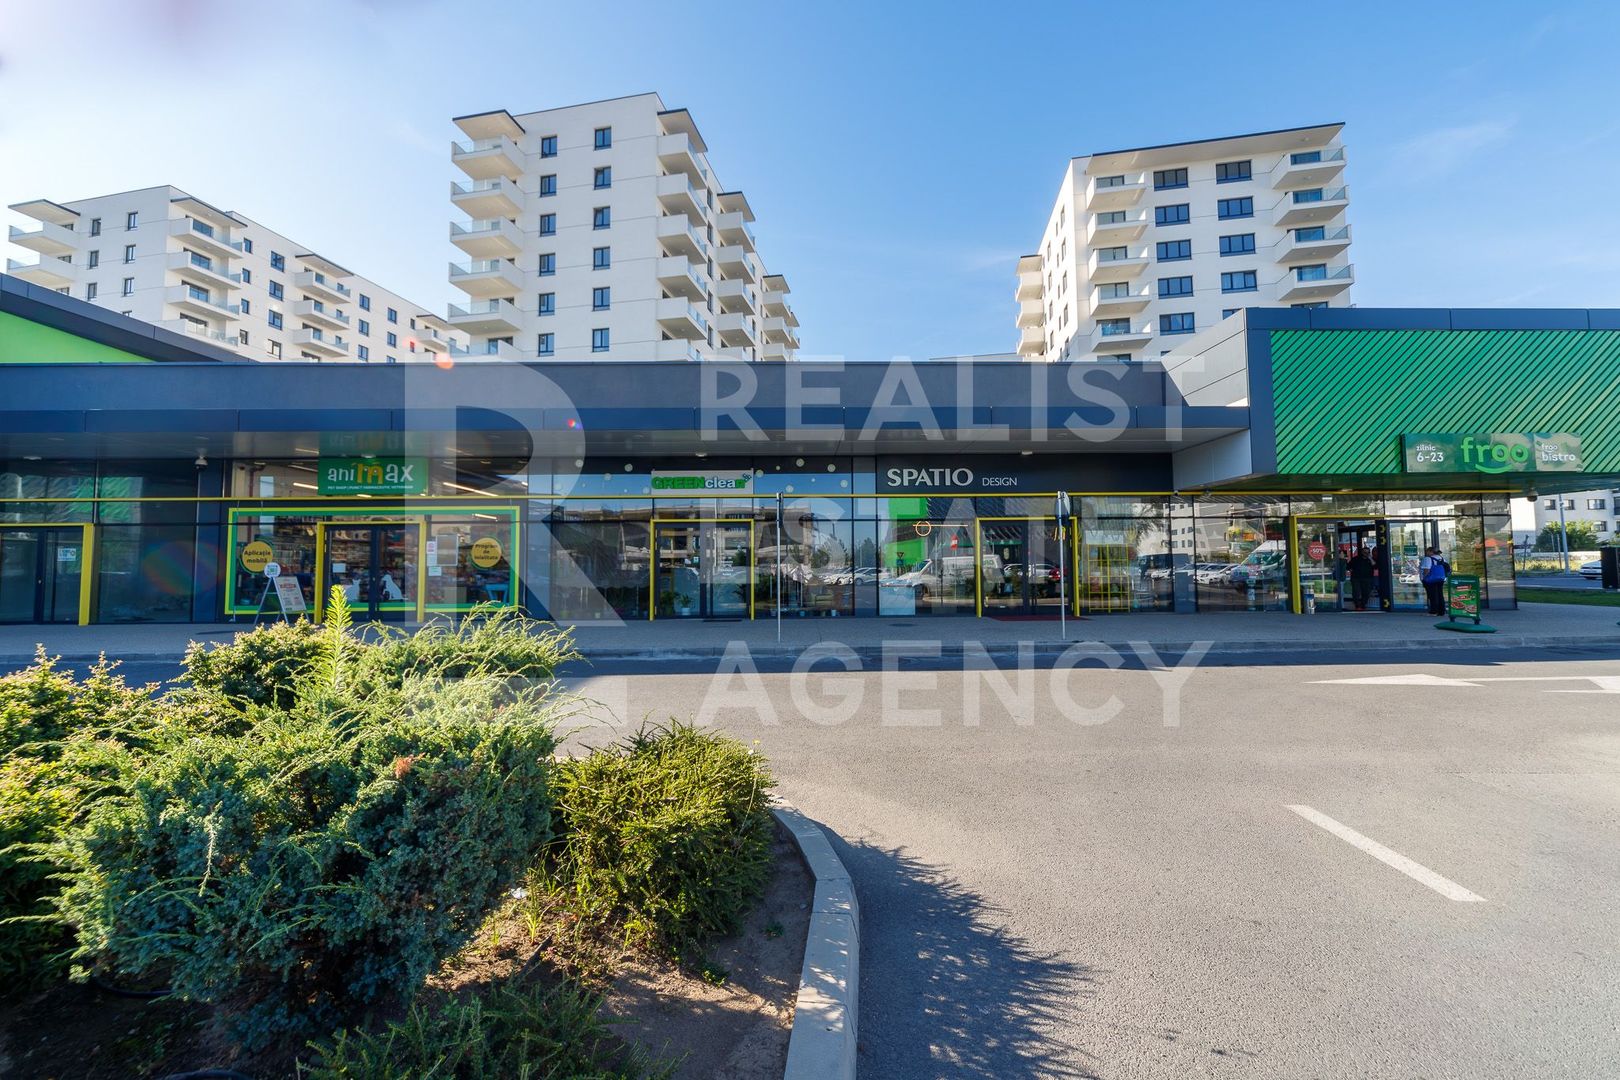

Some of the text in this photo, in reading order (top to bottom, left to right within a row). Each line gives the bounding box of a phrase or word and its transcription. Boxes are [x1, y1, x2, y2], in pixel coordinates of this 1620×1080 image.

[1416, 443, 1436, 451] zilnic
[1461, 437, 1529, 463] froo
[1416, 452, 1444, 462] 6-23
[1541, 451, 1576, 462] bistro
[327, 462, 414, 485] animax
[887, 467, 1018, 487] SPATIO DESIGN
